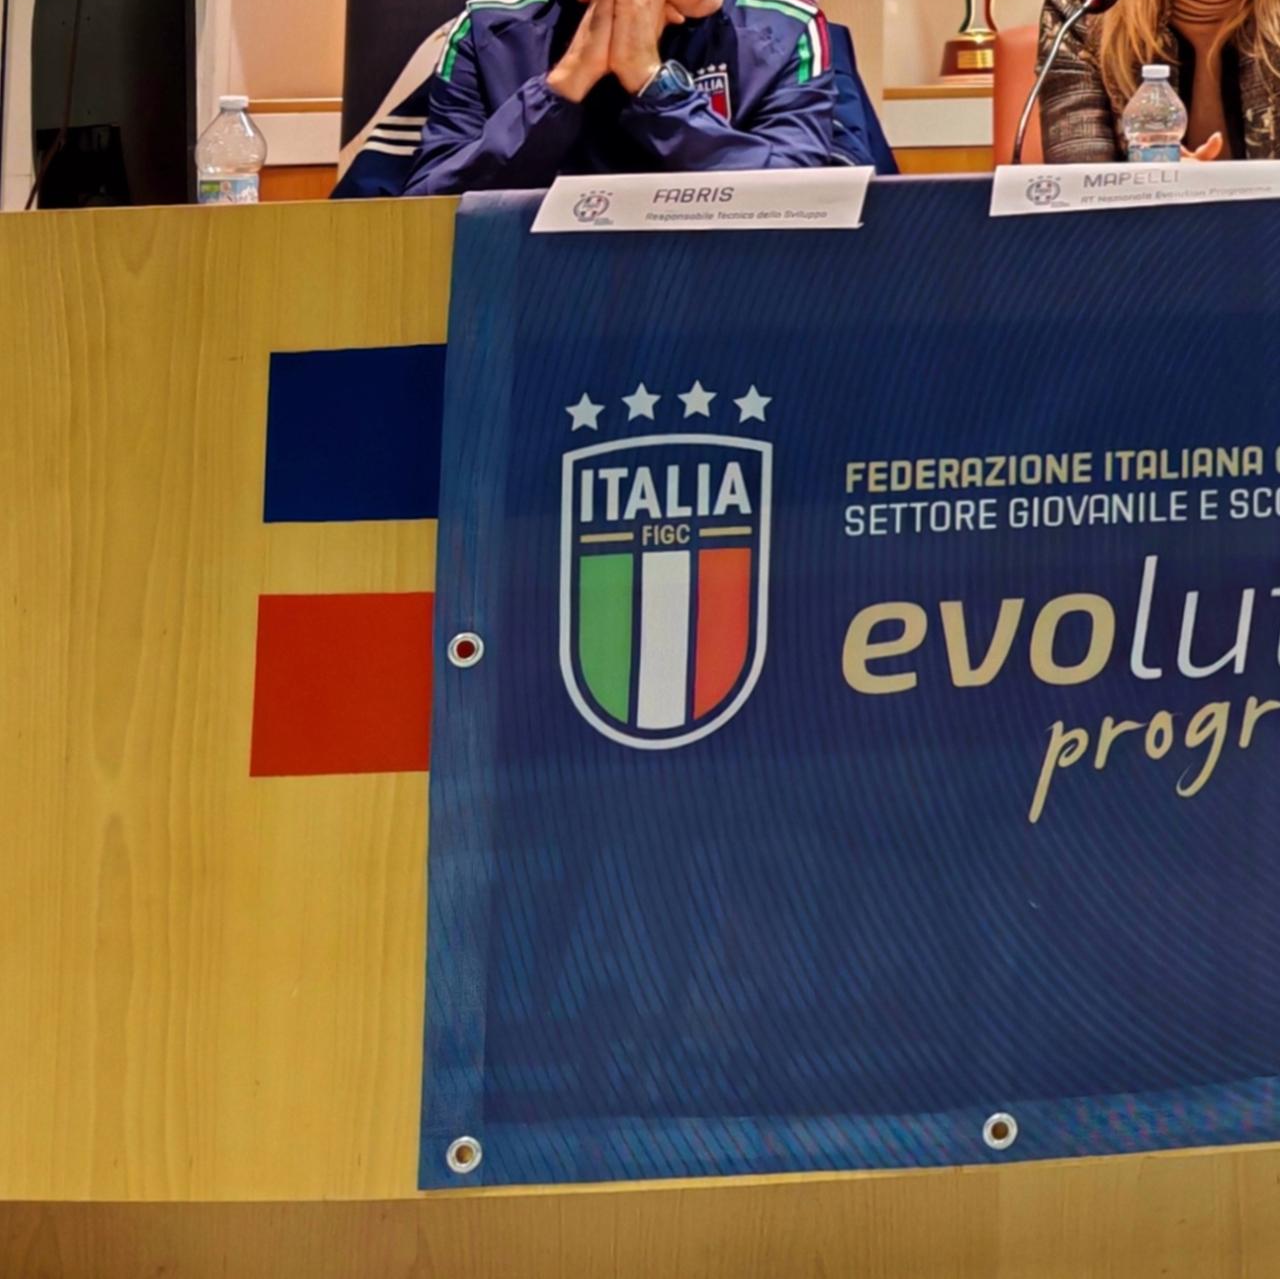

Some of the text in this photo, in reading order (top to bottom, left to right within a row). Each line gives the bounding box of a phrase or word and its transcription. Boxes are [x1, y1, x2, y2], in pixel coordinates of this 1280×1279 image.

[652, 187, 735, 204] FABRIS
[1083, 170, 1179, 188] MAPELLI
[845, 452, 1092, 493] FEDERAZIONE
[1104, 445, 1263, 481] ITALIANA
[579, 460, 753, 522] ITALIA
[844, 497, 998, 537] SETTORE
[1007, 490, 1188, 529] GIOVANILE
[1199, 487, 1218, 521] E
[641, 521, 691, 548] FIGC
